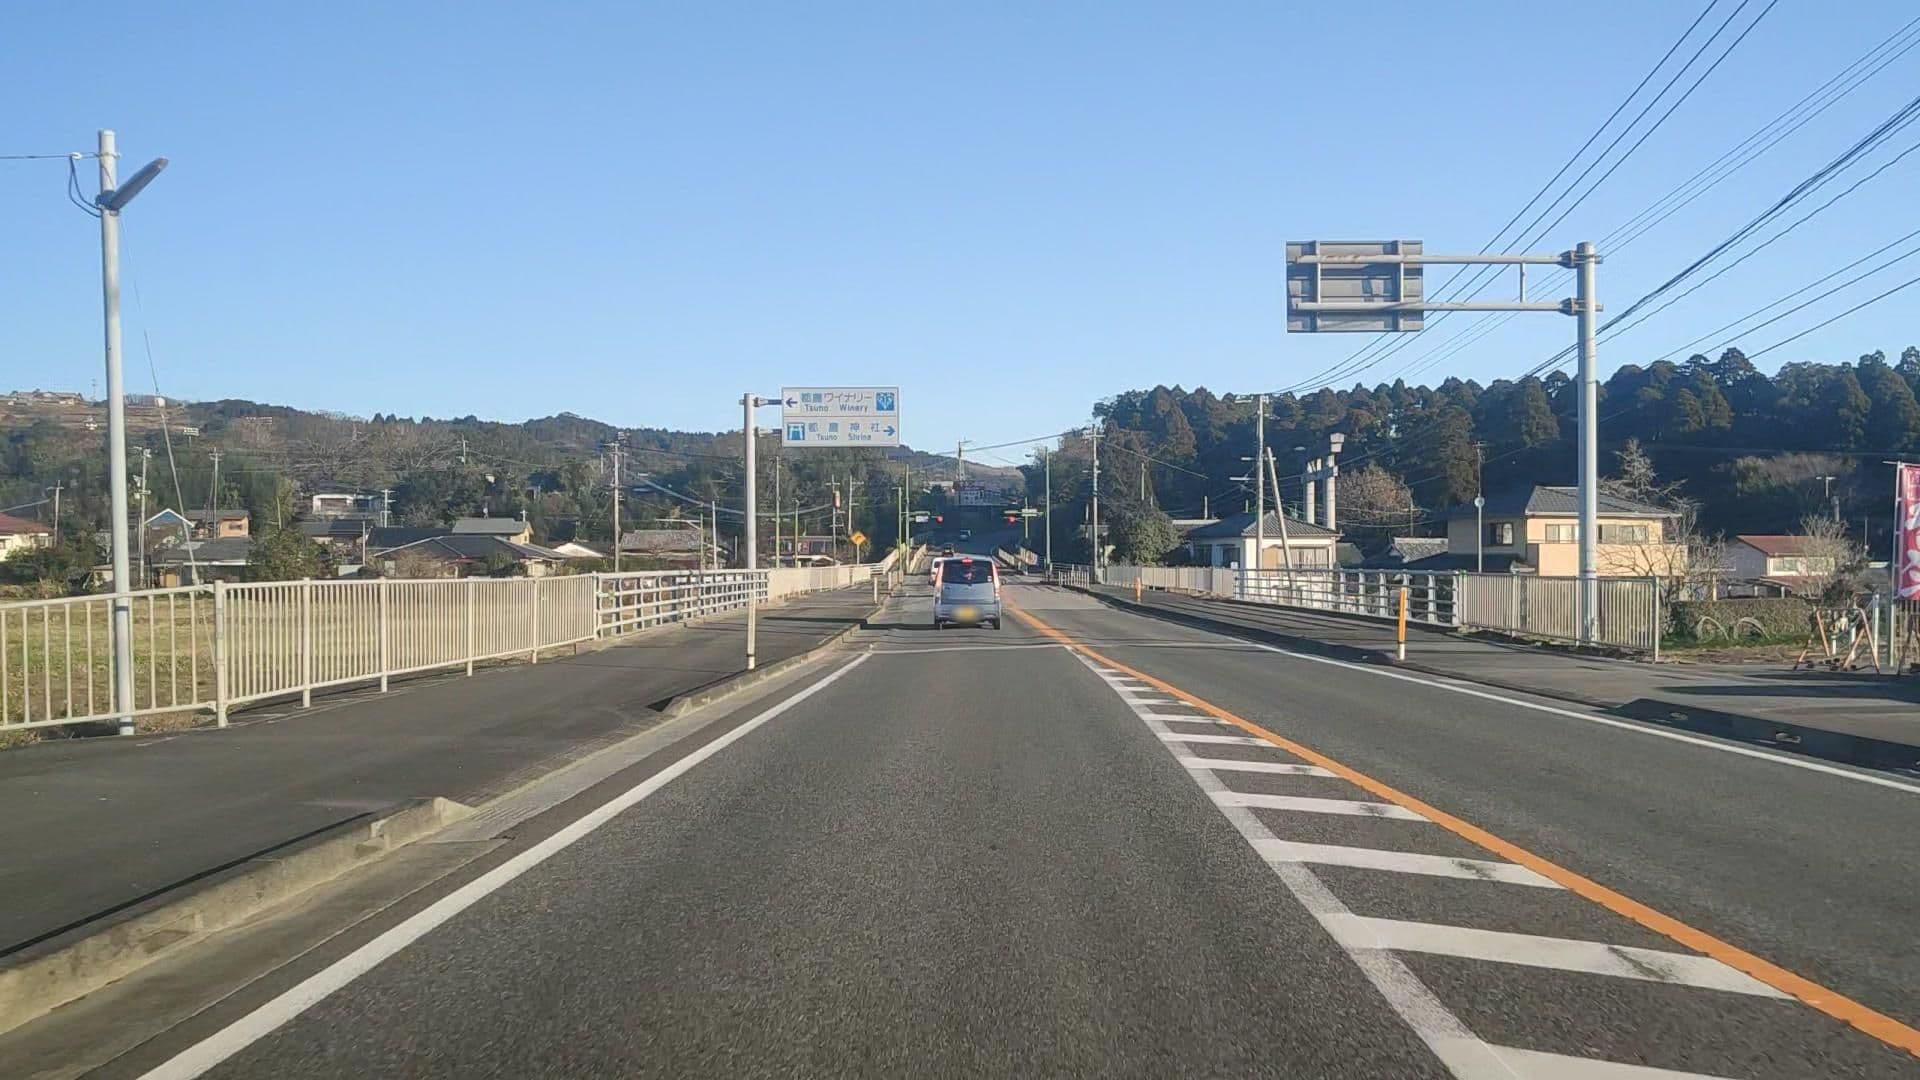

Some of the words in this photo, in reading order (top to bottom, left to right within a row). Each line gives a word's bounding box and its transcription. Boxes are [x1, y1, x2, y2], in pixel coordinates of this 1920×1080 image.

[804, 404, 829, 412] Tsuno
[839, 404, 868, 413] Winery
[817, 433, 838, 441] Tsuno
[848, 433, 872, 441] Shrine
